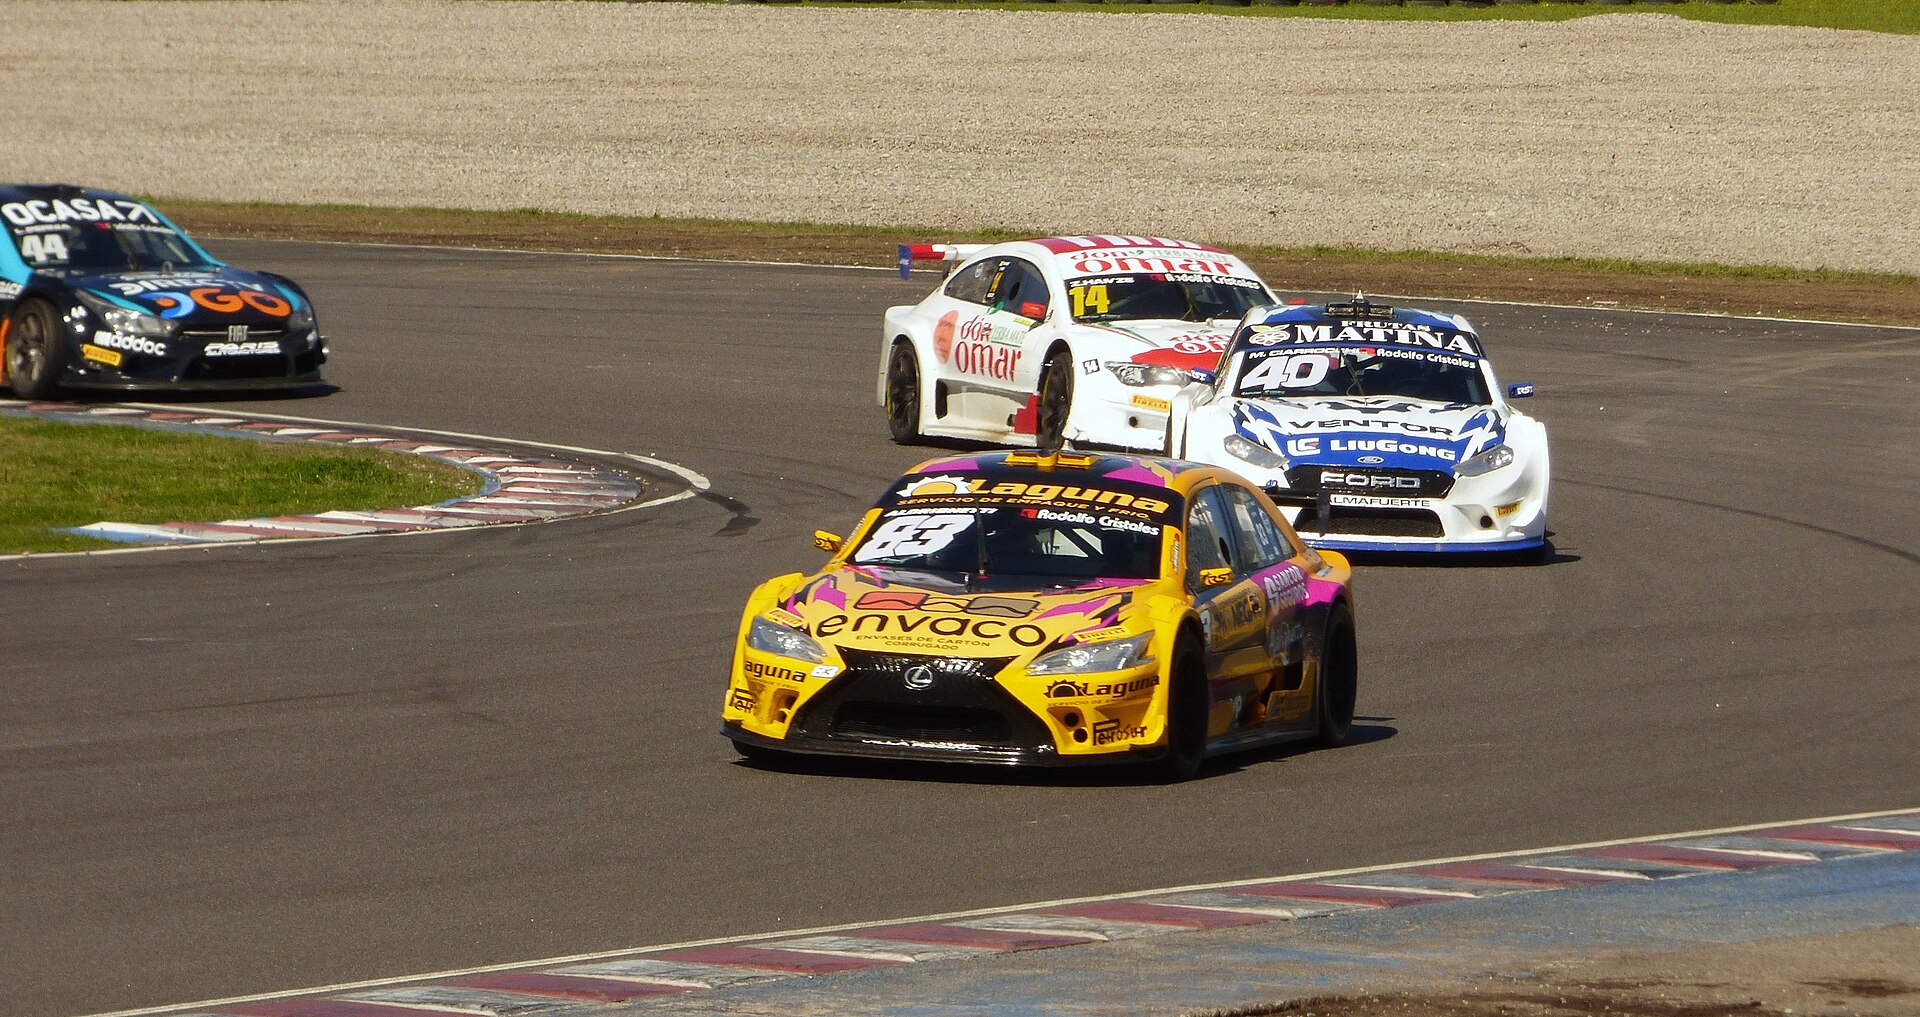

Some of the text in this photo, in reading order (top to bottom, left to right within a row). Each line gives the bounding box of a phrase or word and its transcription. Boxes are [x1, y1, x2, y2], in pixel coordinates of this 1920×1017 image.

[1, 199, 127, 226] OCASA
[22, 233, 70, 263] 44
[1074, 257, 1235, 275] omar
[1068, 285, 1111, 317] 14
[1341, 320, 1431, 332] FRUTAS
[1294, 324, 1479, 357] MATINA
[954, 341, 1022, 382] omar
[1376, 348, 1477, 369] Rodolfo Cristales
[1239, 354, 1330, 391] 40
[1288, 418, 1454, 436] VENTOR
[1320, 470, 1421, 489] FORD
[897, 497, 975, 506] SERVICIO
[1006, 498, 1090, 509] EMPAQUE
[970, 478, 1170, 514] Laguna
[1330, 496, 1431, 508] LMAFUERTE
[1037, 508, 1160, 536] Rodolfo Cristales
[855, 514, 976, 563] 83
[815, 613, 1047, 647] envaco
[856, 634, 916, 642] ENVASES
[884, 640, 959, 651] CORRUGADO
[744, 660, 807, 683] aguna
[1082, 674, 1160, 699] Laguna
